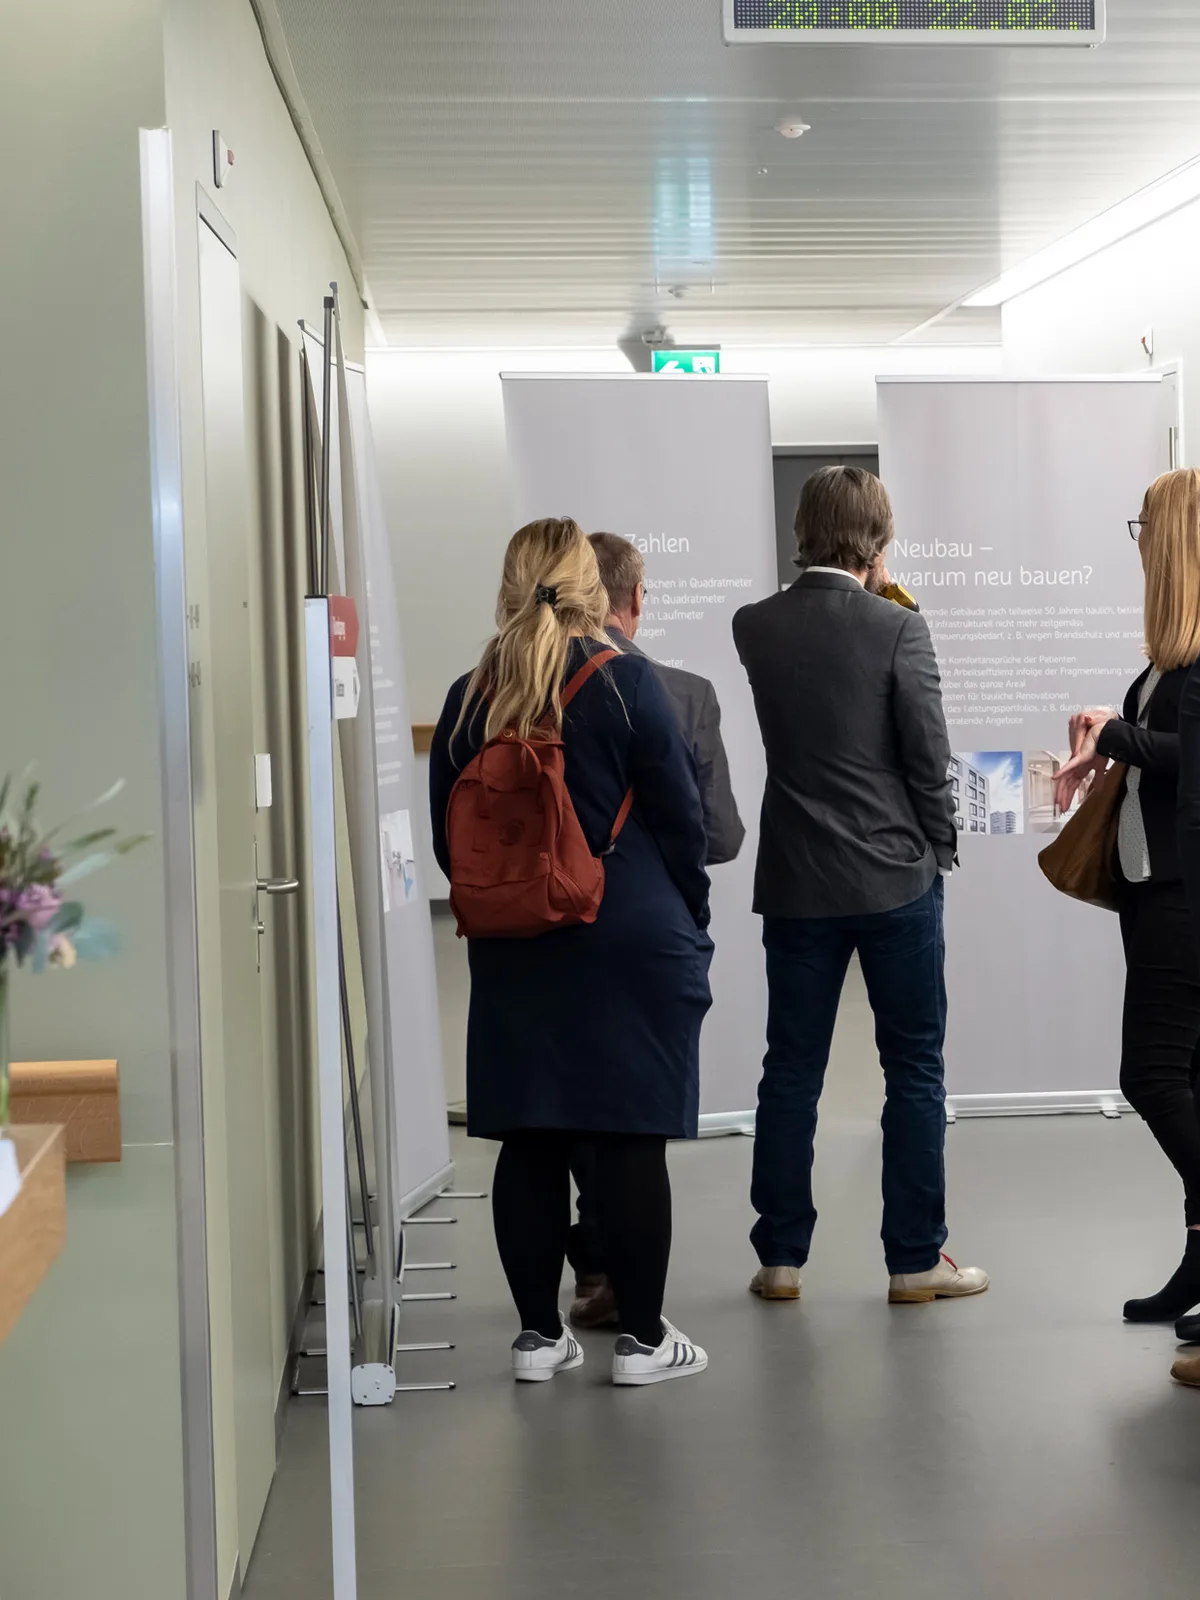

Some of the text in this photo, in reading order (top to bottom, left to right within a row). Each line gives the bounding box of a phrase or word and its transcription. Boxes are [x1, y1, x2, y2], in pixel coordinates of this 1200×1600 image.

[893, 538, 973, 558] Neubau
[893, 565, 1093, 587] warum neu bauen?
[644, 577, 753, 589] lächen in Quadratmeter
[651, 595, 660, 605] in
[662, 593, 727, 605] Quadratmeter
[657, 608, 705, 621] Laufmeter
[950, 606, 986, 616] Gebäude
[987, 606, 1007, 616] nach
[1044, 606, 1056, 615] 50
[1057, 605, 1085, 616] Jahren
[995, 619, 1015, 628] nicht
[1016, 618, 1038, 628] mehr
[1025, 631, 1053, 641] wegen
[1054, 630, 1103, 640] Brandschutz
[1105, 630, 1120, 640] und
[949, 655, 1022, 666] Komfortansprüche
[1024, 655, 1037, 664] der
[1015, 667, 1043, 678] infolge
[1044, 667, 1058, 676] der
[1060, 667, 1122, 678] Fragmentierung
[963, 680, 978, 688] das
[979, 680, 1004, 690] ganze
[1005, 679, 1026, 688] Areal
[968, 692, 979, 701] für
[981, 691, 1014, 700] bauliche
[1015, 691, 1070, 701] Renovationen
[947, 704, 962, 713] des
[1059, 703, 1082, 712] durch
[985, 716, 1024, 726] Angebote
